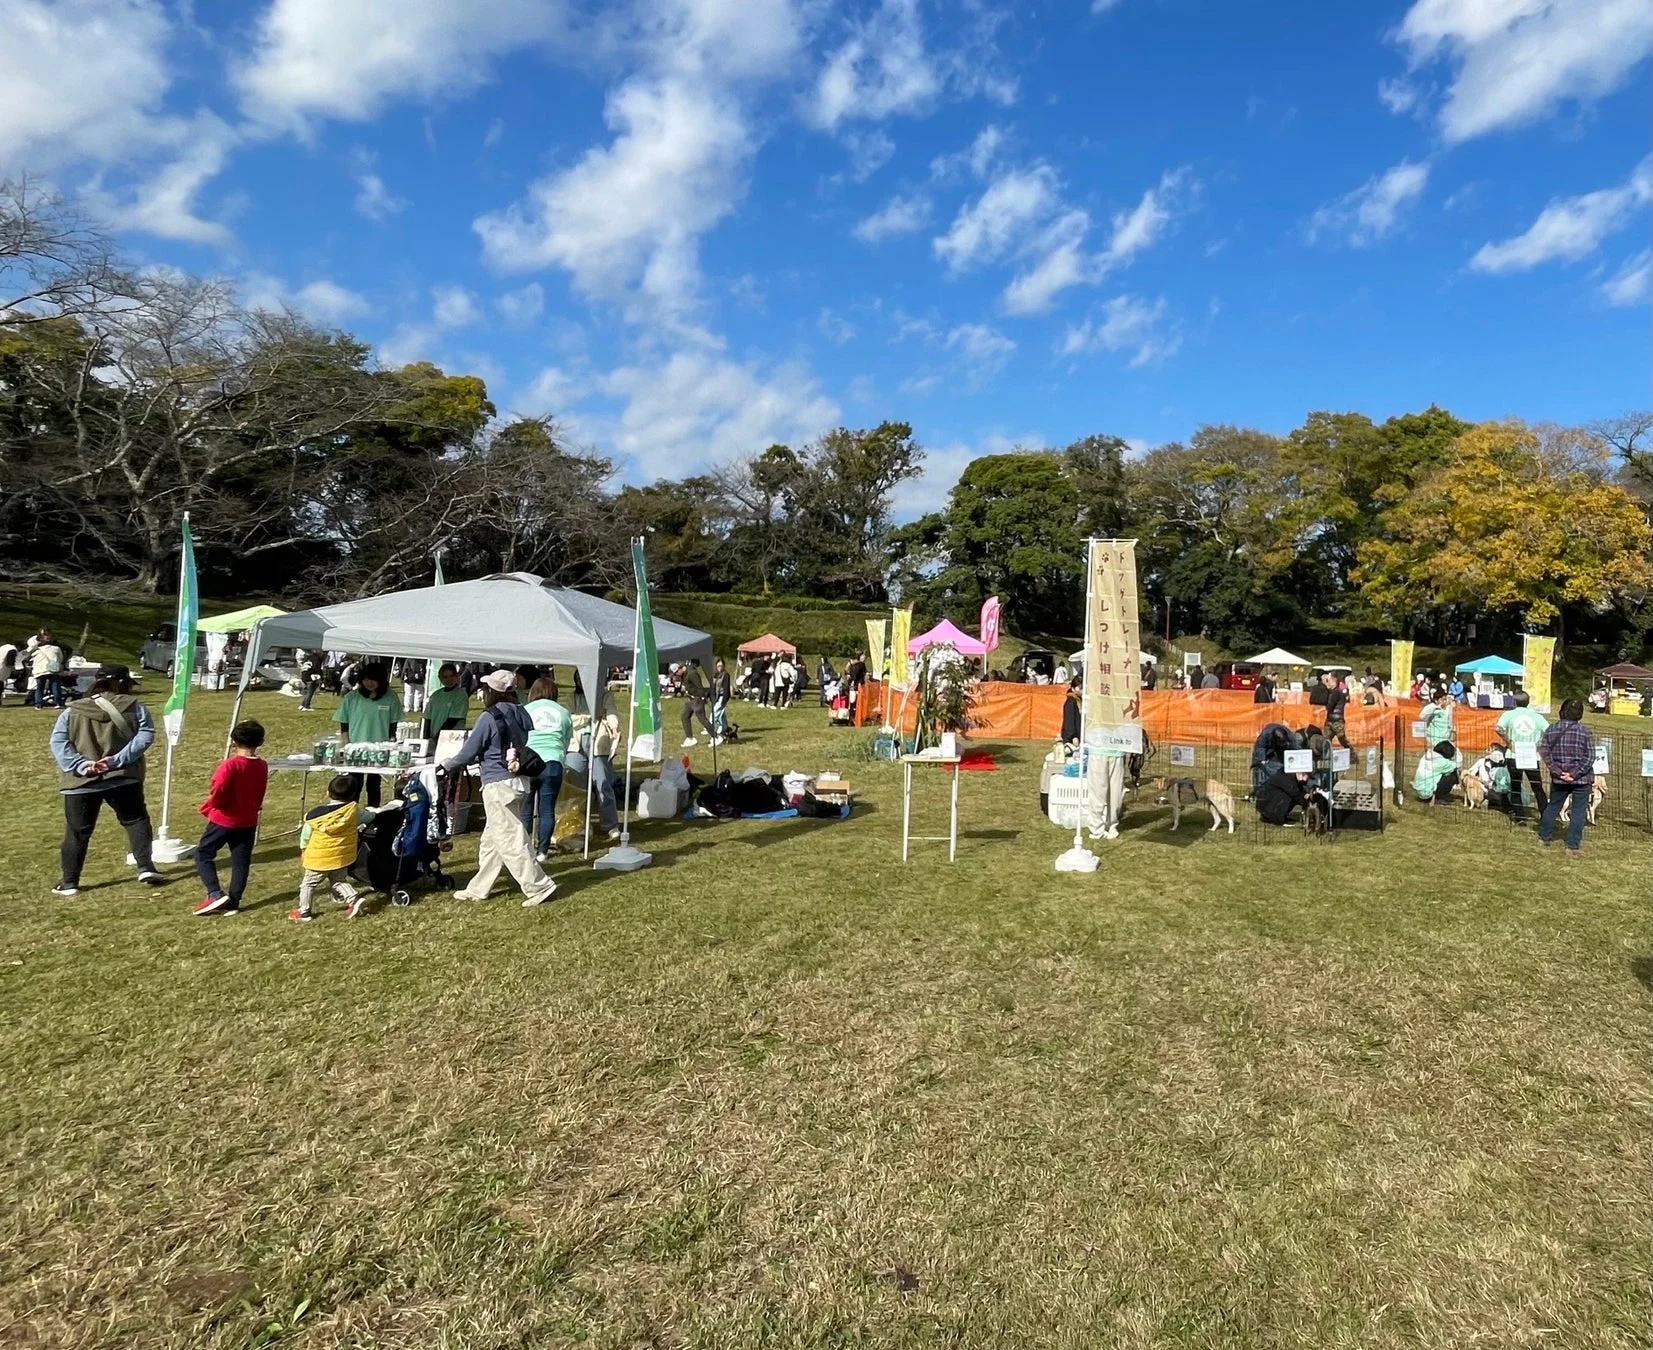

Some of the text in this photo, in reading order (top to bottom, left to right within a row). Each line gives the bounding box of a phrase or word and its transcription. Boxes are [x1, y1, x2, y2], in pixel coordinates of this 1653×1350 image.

[1099, 599, 1111, 696] しつけ相談
[1109, 736, 1124, 745] Link
